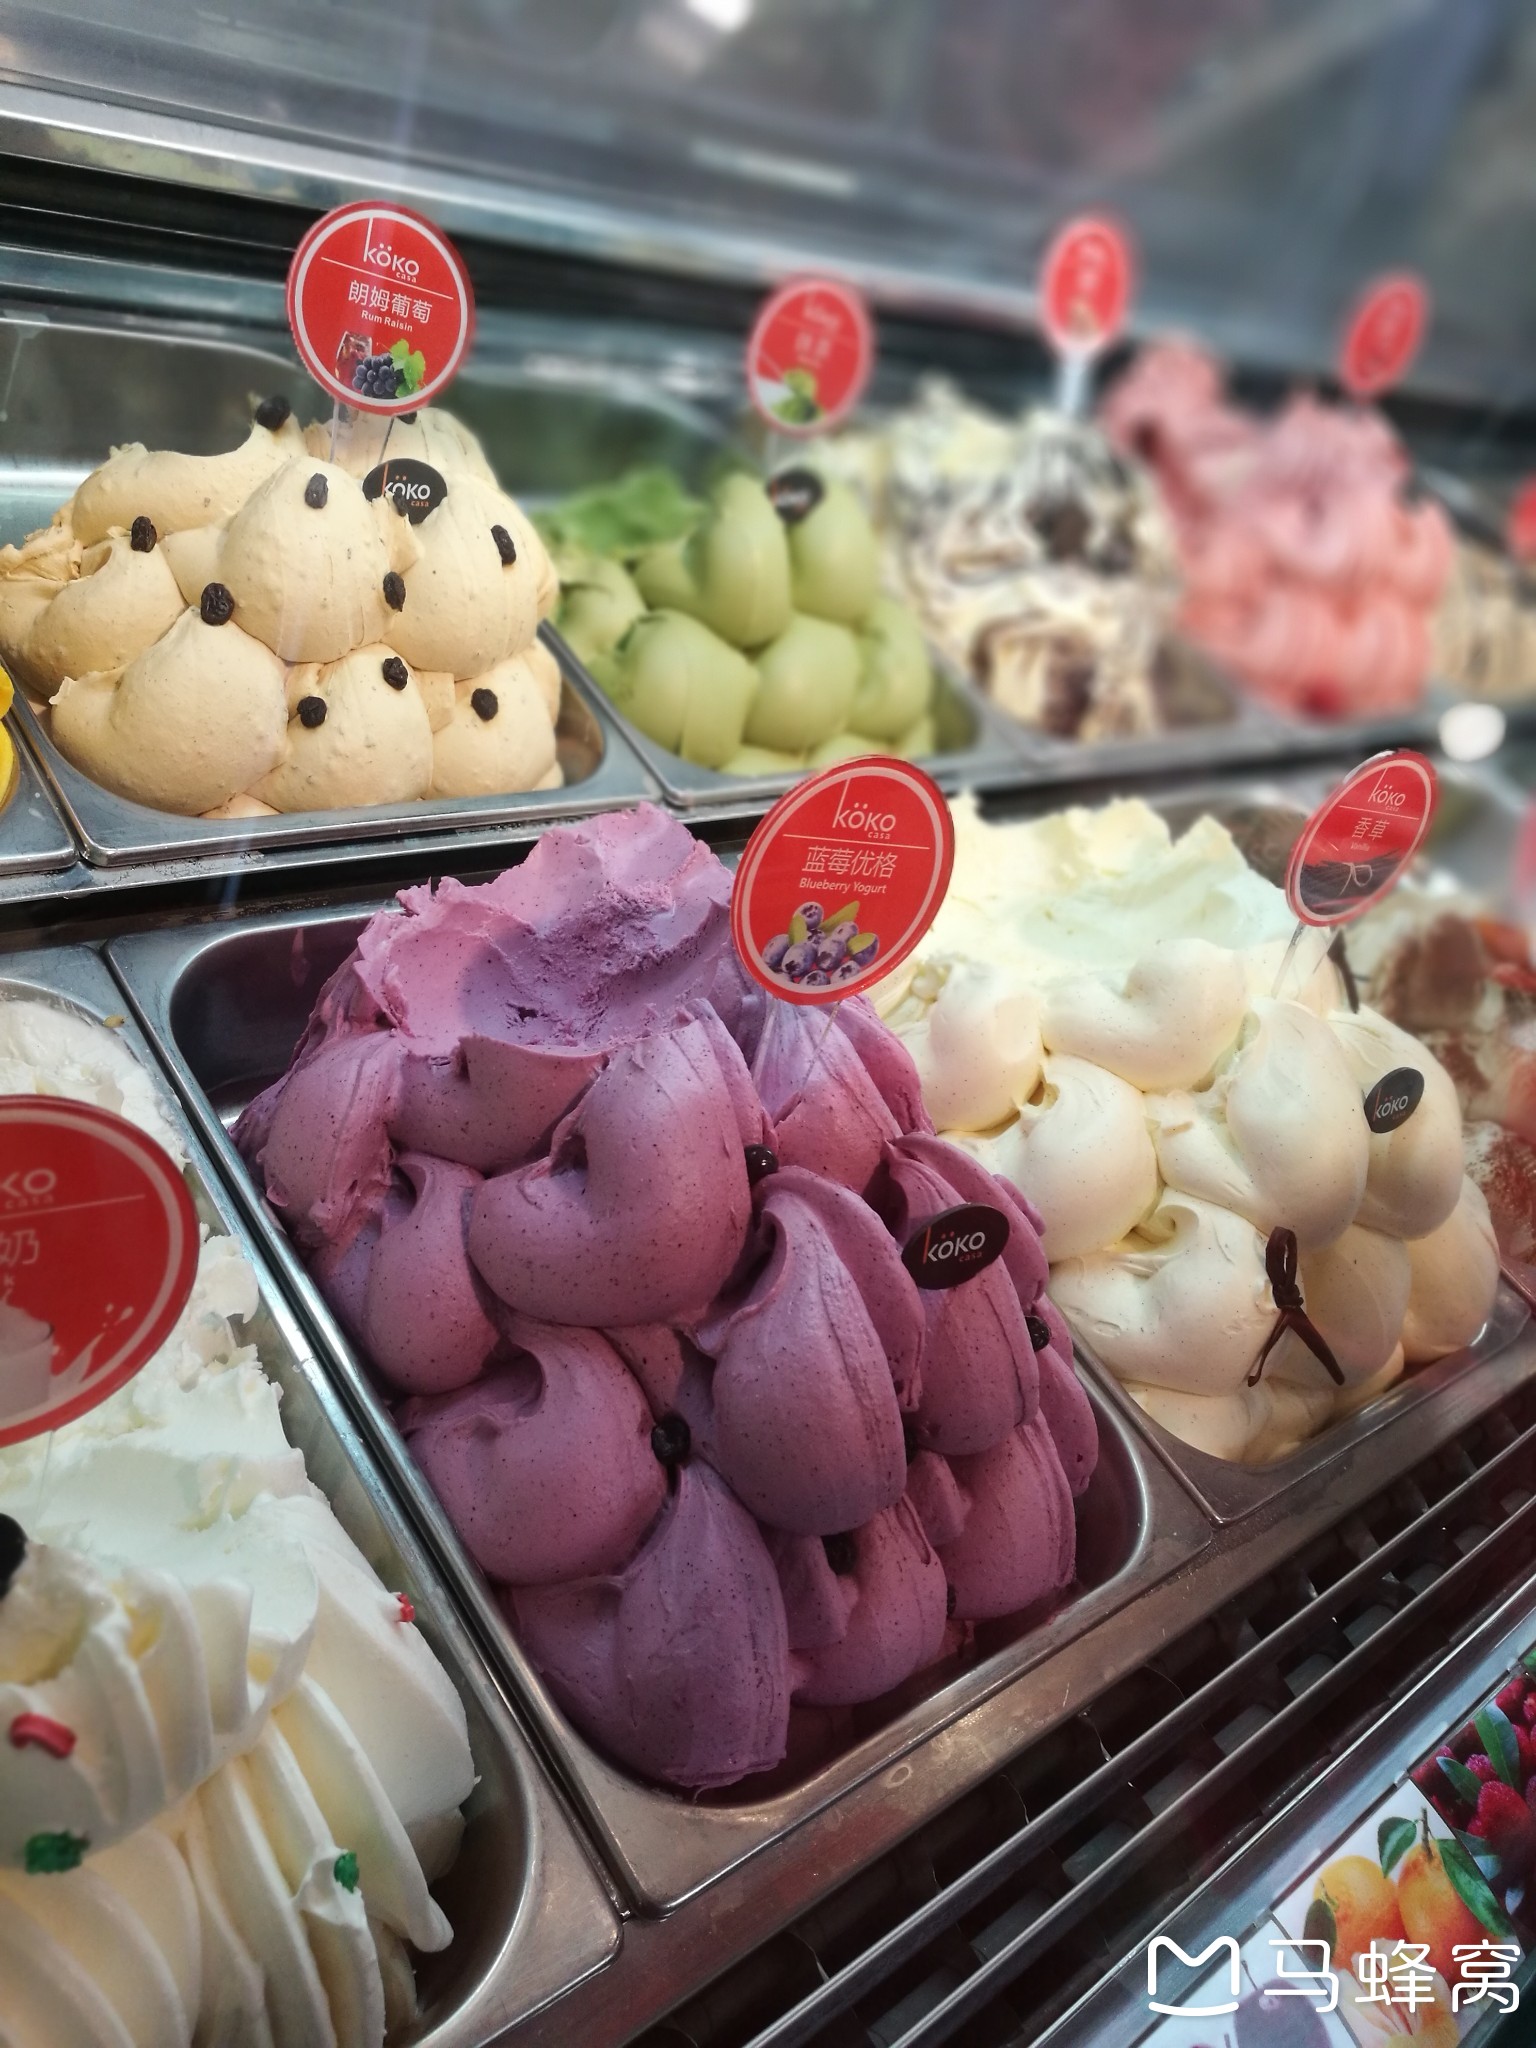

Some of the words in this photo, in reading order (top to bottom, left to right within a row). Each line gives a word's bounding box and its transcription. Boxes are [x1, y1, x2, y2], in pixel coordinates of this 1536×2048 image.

[396, 271, 417, 283] casa
[348, 279, 433, 324] 朗姆葡萄
[361, 309, 383, 324] Rum
[384, 317, 413, 332] Raisin
[410, 499, 430, 507] casa
[867, 831, 891, 840] casa
[1351, 817, 1390, 840] 香草
[801, 845, 898, 879] 蓝莓优格
[799, 877, 850, 894] Blueberry
[853, 881, 887, 896] Yogurt
